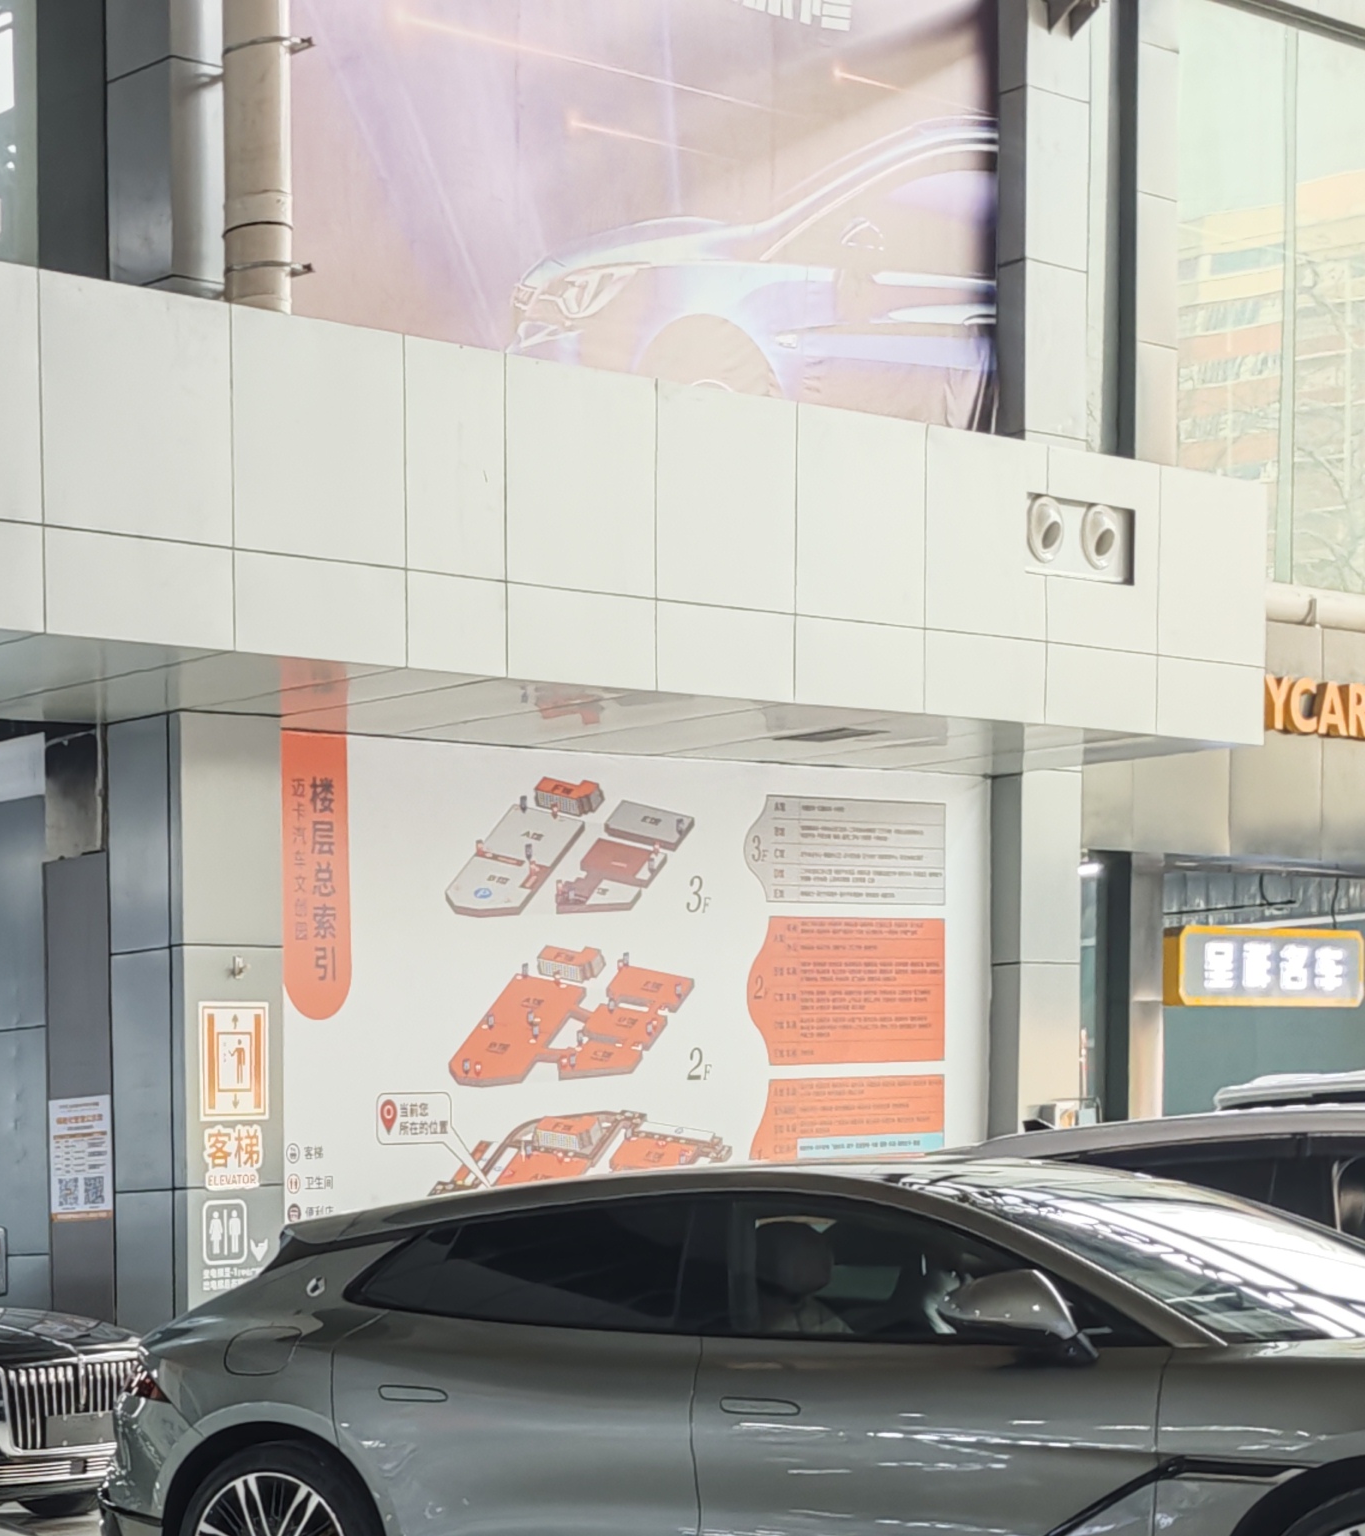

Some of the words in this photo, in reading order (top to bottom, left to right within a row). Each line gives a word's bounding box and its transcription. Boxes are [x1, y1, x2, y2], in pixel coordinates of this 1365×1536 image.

[310, 776, 337, 982] 楼层总索引
[686, 875, 712, 914] 3F
[686, 1047, 713, 1081] 2F
[399, 1121, 449, 1136] 所在的位置
[207, 1128, 261, 1169] 客梯
[304, 1146, 324, 1160] 客梯
[208, 1174, 257, 1187] ELEVATOR
[305, 1176, 334, 1190] 卫生间
